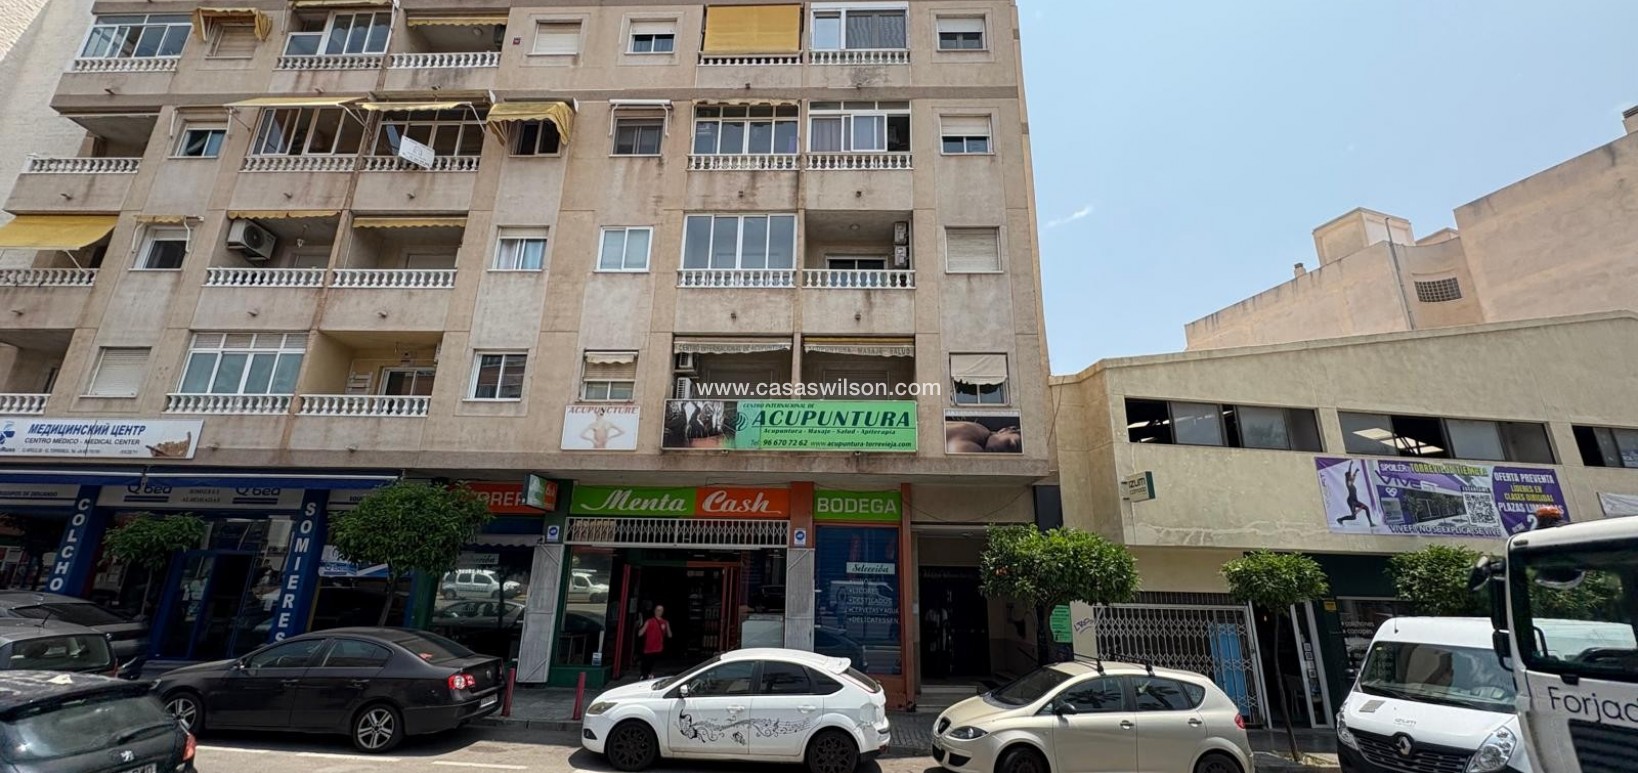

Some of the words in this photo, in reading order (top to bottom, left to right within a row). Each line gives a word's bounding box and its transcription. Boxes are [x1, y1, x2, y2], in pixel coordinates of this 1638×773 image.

[568, 406, 638, 414] ACUPUNCTURE
[752, 410, 909, 426] ACUPUNTURA
[28, 422, 110, 436] МЕДИЦИНСКИЙ
[110, 425, 146, 437] ЦЕНТР
[1494, 472, 1519, 482] OFERTA
[1520, 473, 1555, 484] PREVENTA
[580, 489, 688, 512] Menta
[702, 490, 782, 514] Cash
[817, 497, 897, 514] BODEGA
[1498, 502, 1525, 512] PLAZAS
[275, 502, 317, 641] SOMIERES
